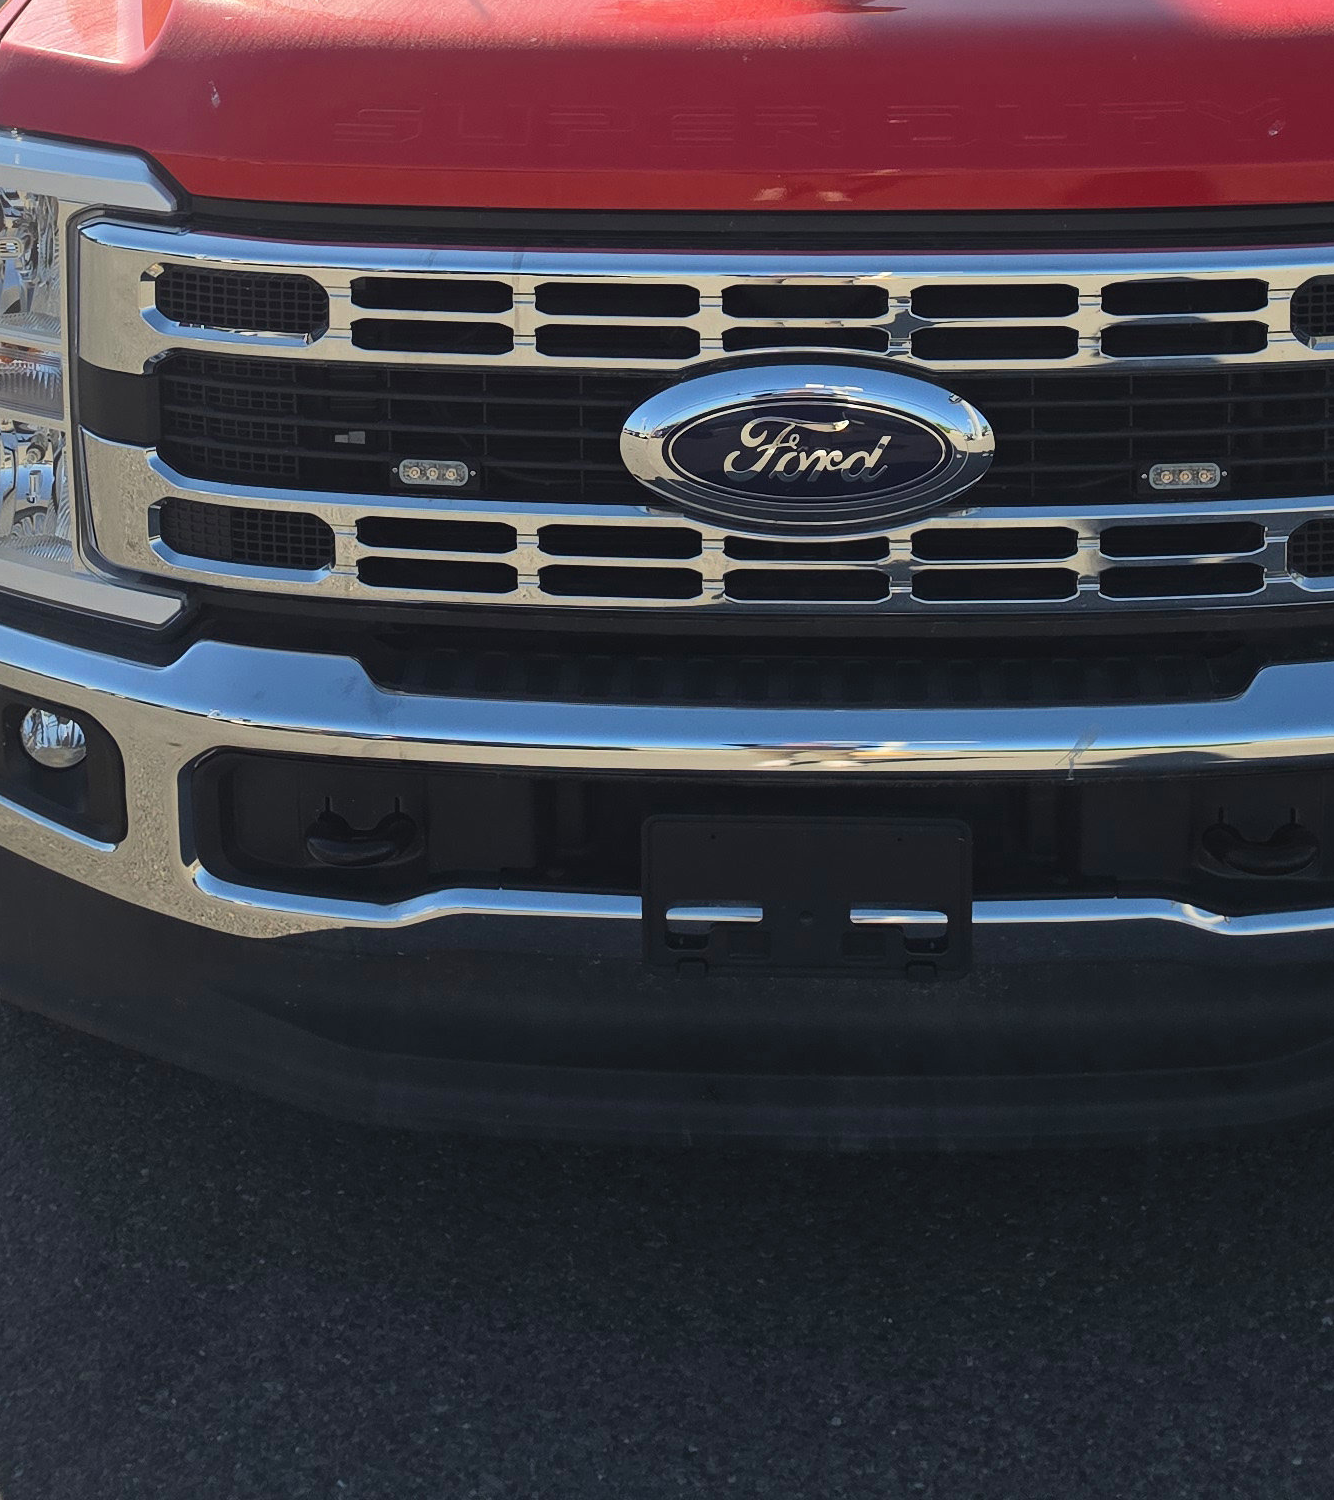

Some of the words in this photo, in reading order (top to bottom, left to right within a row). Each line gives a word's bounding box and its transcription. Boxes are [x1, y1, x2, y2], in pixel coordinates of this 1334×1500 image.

[333, 104, 843, 148] SUPER
[884, 98, 1285, 147] DUTY
[723, 416, 889, 483] Ford
